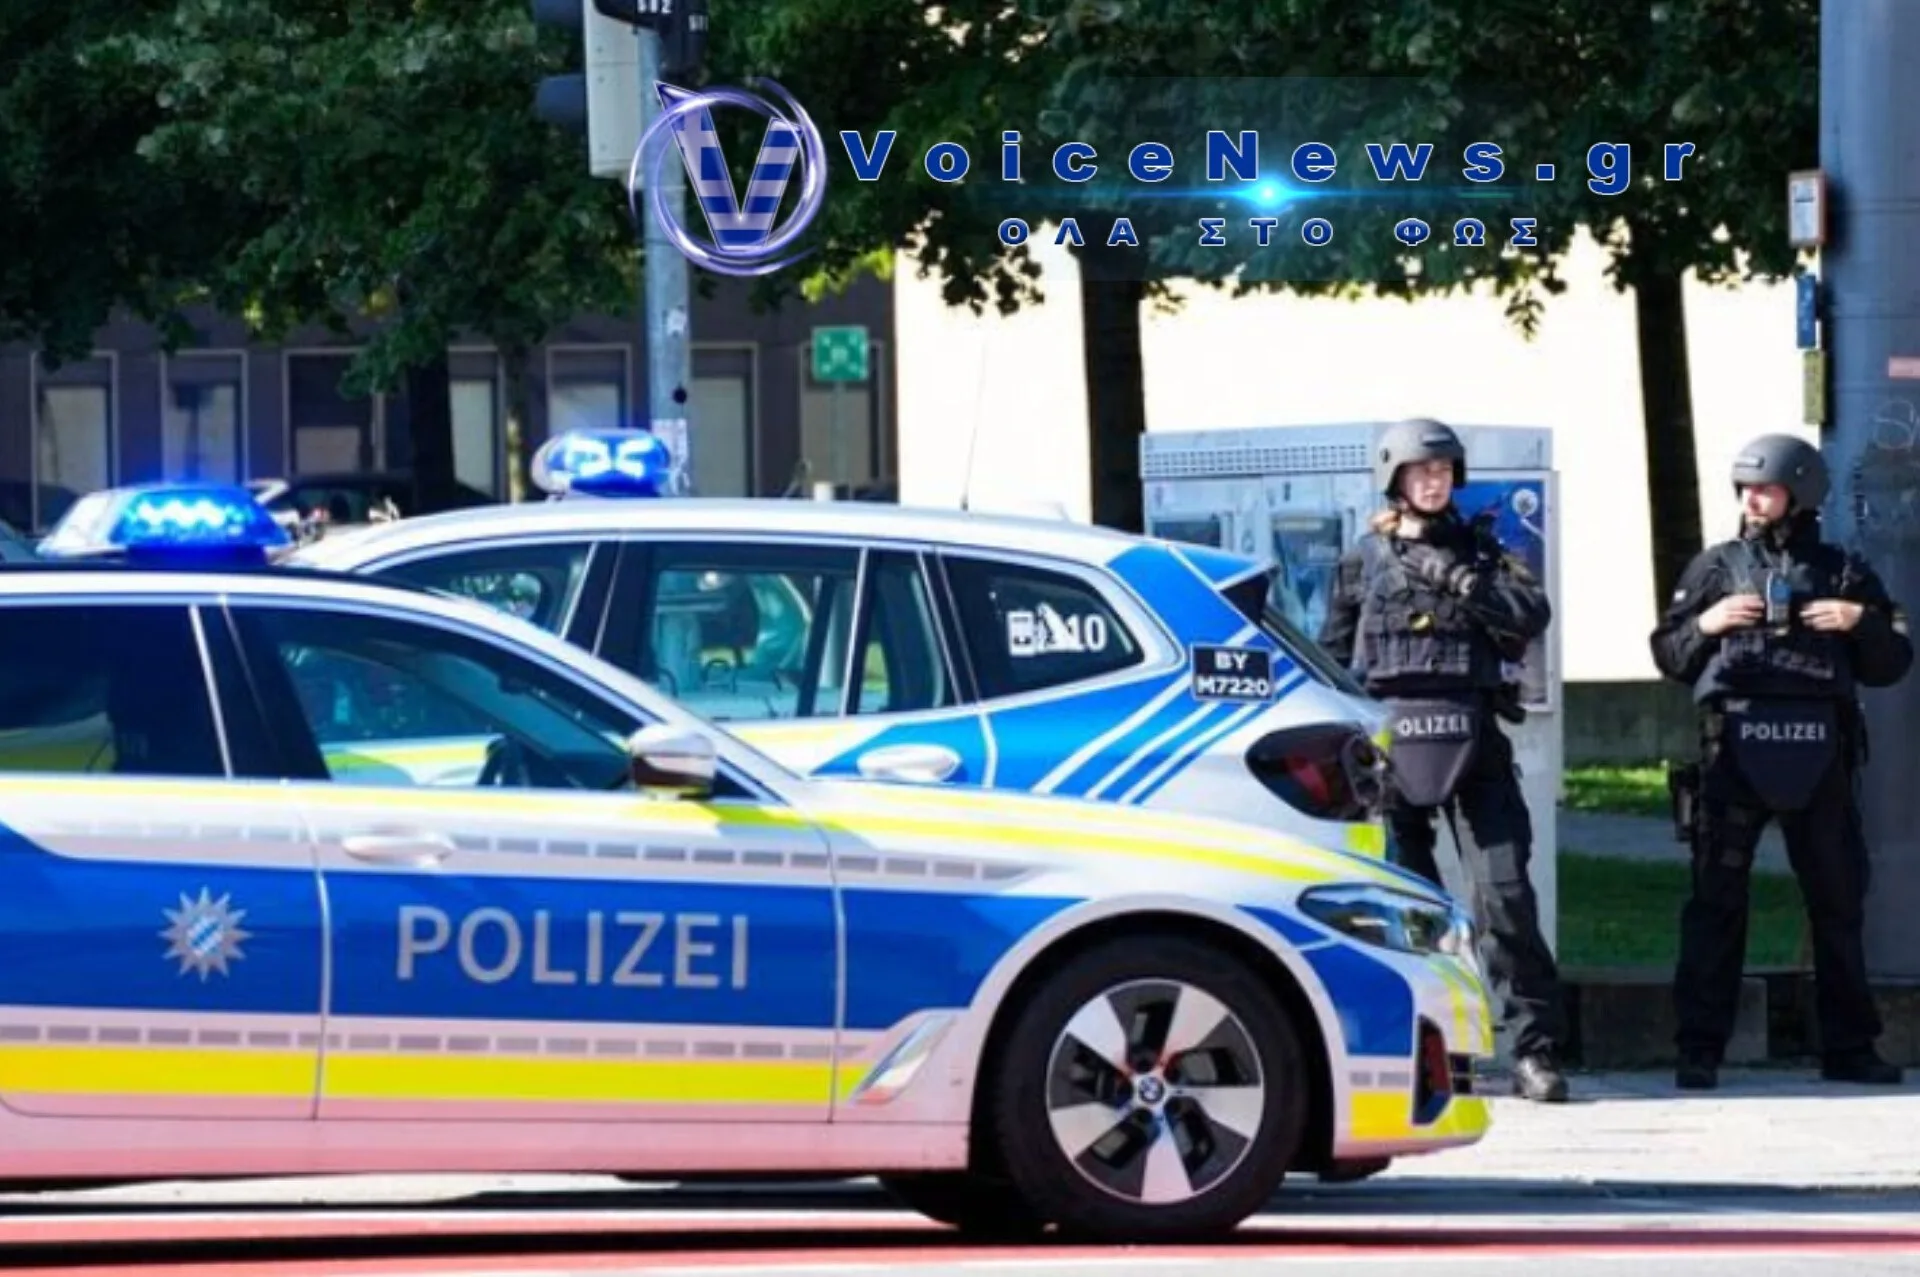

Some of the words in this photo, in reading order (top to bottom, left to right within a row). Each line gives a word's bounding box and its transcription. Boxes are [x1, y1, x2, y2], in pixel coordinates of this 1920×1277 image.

[1215, 651, 1249, 671] BY
[1197, 675, 1270, 697] M7220
[1393, 714, 1469, 737] OLIZEI
[1740, 721, 1826, 741] POLIZEI
[397, 904, 748, 991] POLIZEI
